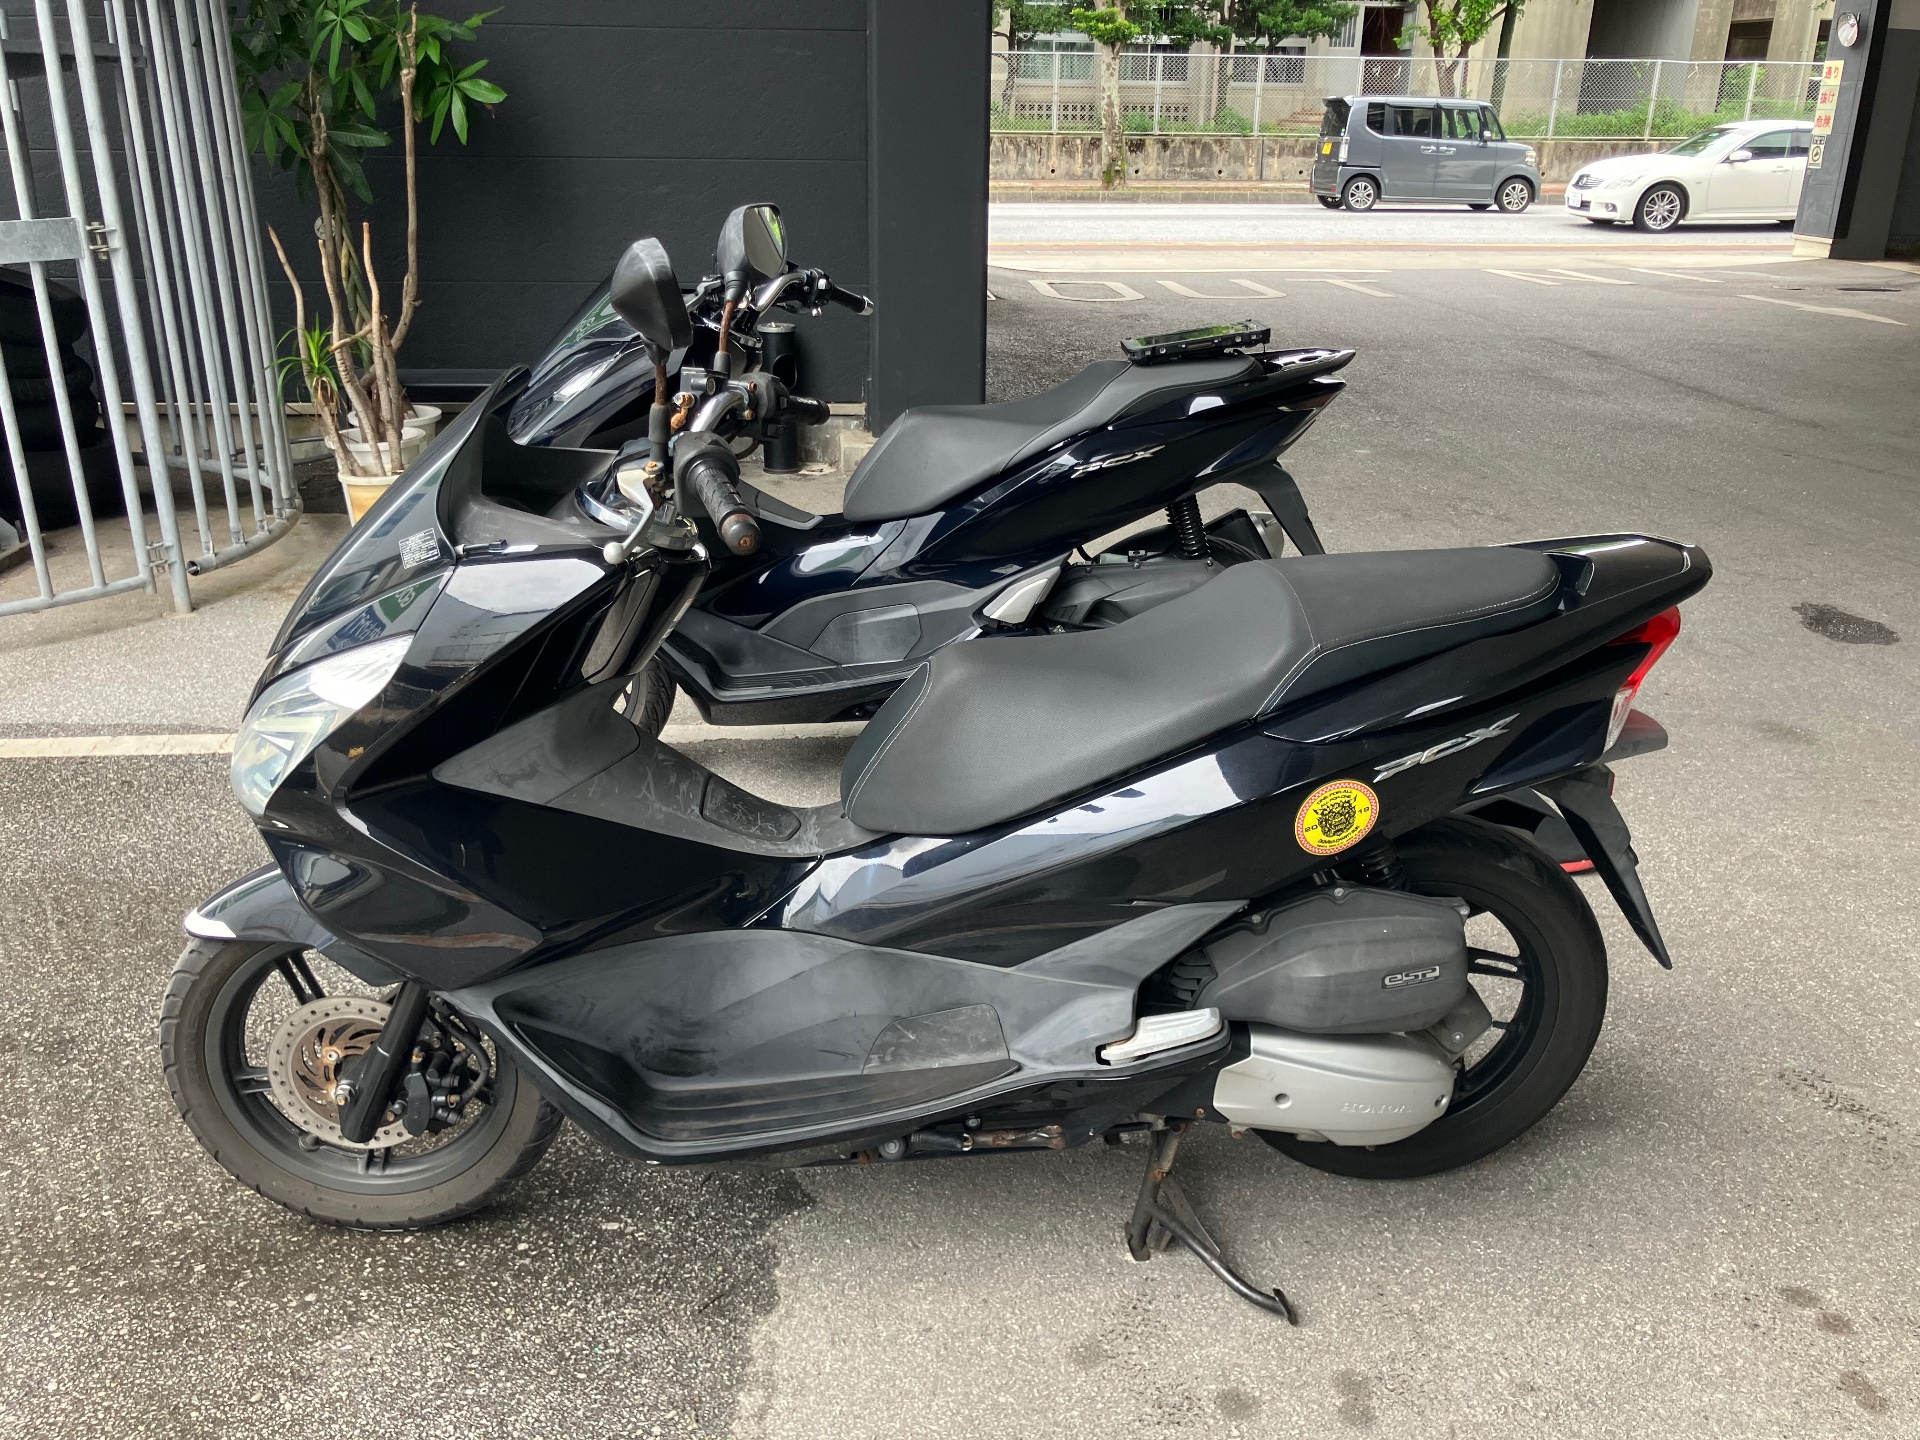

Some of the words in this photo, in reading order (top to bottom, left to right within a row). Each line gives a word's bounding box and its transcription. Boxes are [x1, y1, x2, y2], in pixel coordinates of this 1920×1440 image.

[1824, 66, 1839, 79] 通り
[1820, 91, 1836, 104] 抜け
[1815, 115, 1831, 128] 危険
[1027, 278, 1397, 302] OUT
[1071, 445, 1166, 479] PCX
[1373, 712, 1521, 784] PCX
[1339, 1102, 1412, 1114] HONDA
